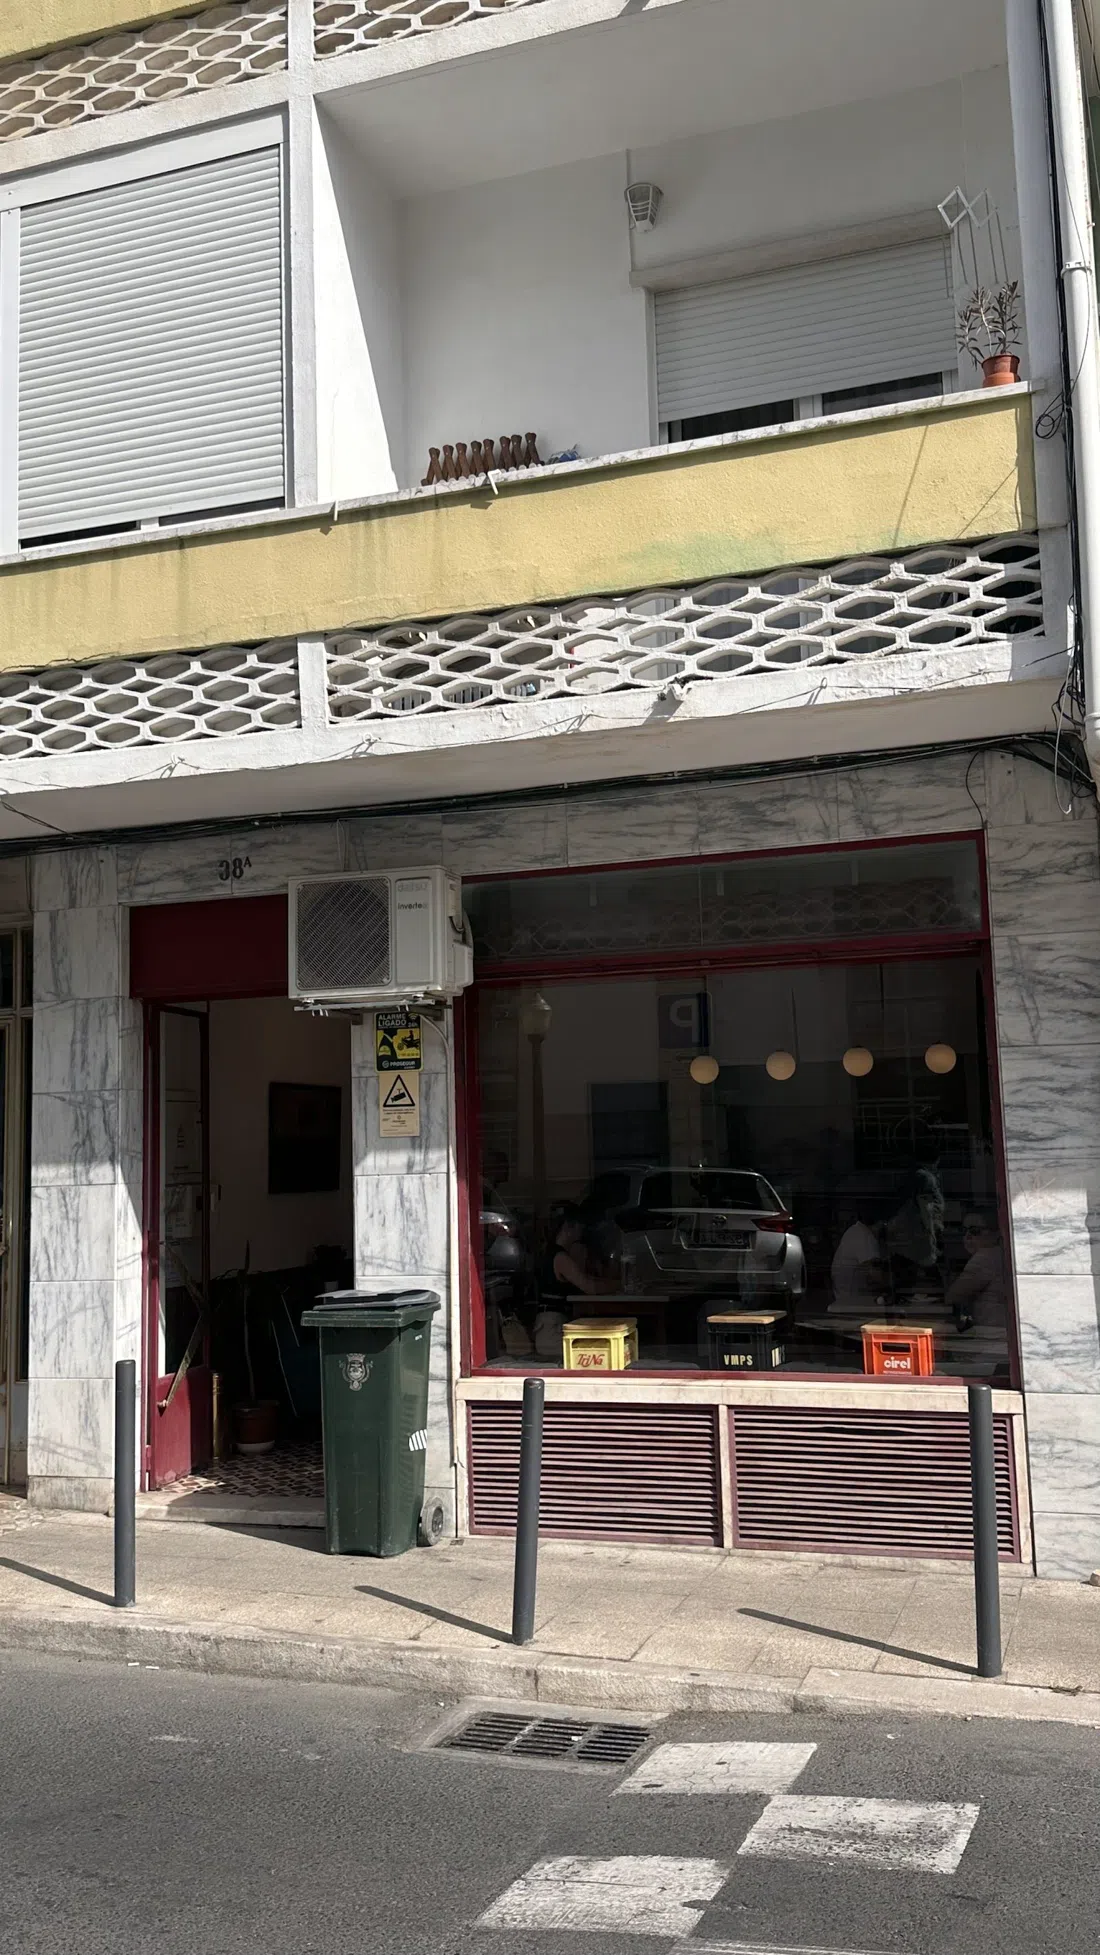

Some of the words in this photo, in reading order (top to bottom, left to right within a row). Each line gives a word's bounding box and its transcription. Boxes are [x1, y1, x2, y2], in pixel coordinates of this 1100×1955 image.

[378, 1013, 407, 1021] ALARME
[378, 1019, 407, 1027] LIGADO
[723, 1354, 753, 1366] VMPS
[884, 1356, 911, 1369] cirel
